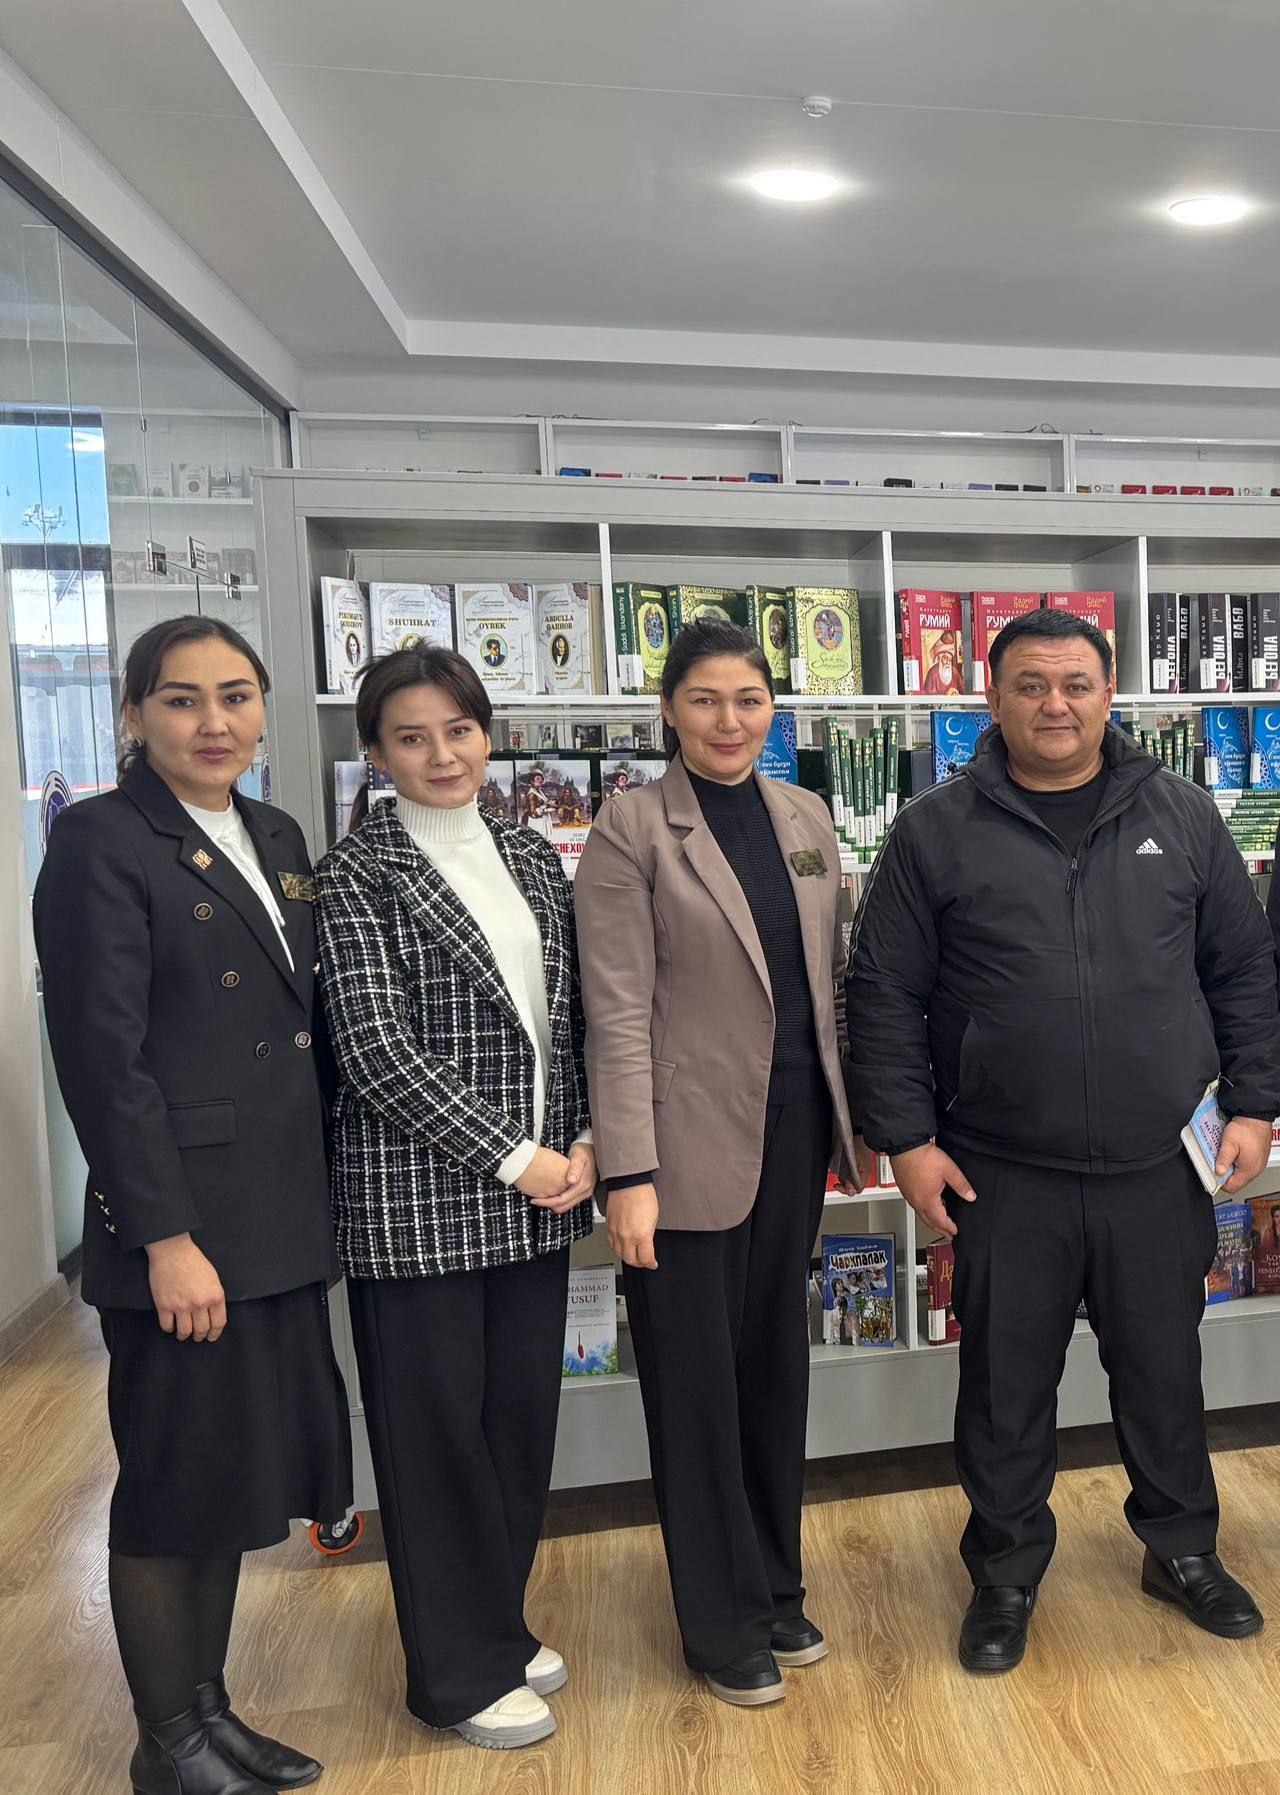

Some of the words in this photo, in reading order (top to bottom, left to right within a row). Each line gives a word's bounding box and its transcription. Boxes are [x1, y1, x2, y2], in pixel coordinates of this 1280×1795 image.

[388, 618, 437, 627] SHUHRAT
[545, 615, 574, 623] ABDULLA
[920, 613, 951, 628] РУМИЙ
[986, 615, 1015, 629] РУМ
[479, 622, 506, 630] OYBEK
[830, 1249, 887, 1270] Чархпалак
[568, 1284, 609, 1292] HAMMAD
[568, 1294, 599, 1304] USUF
